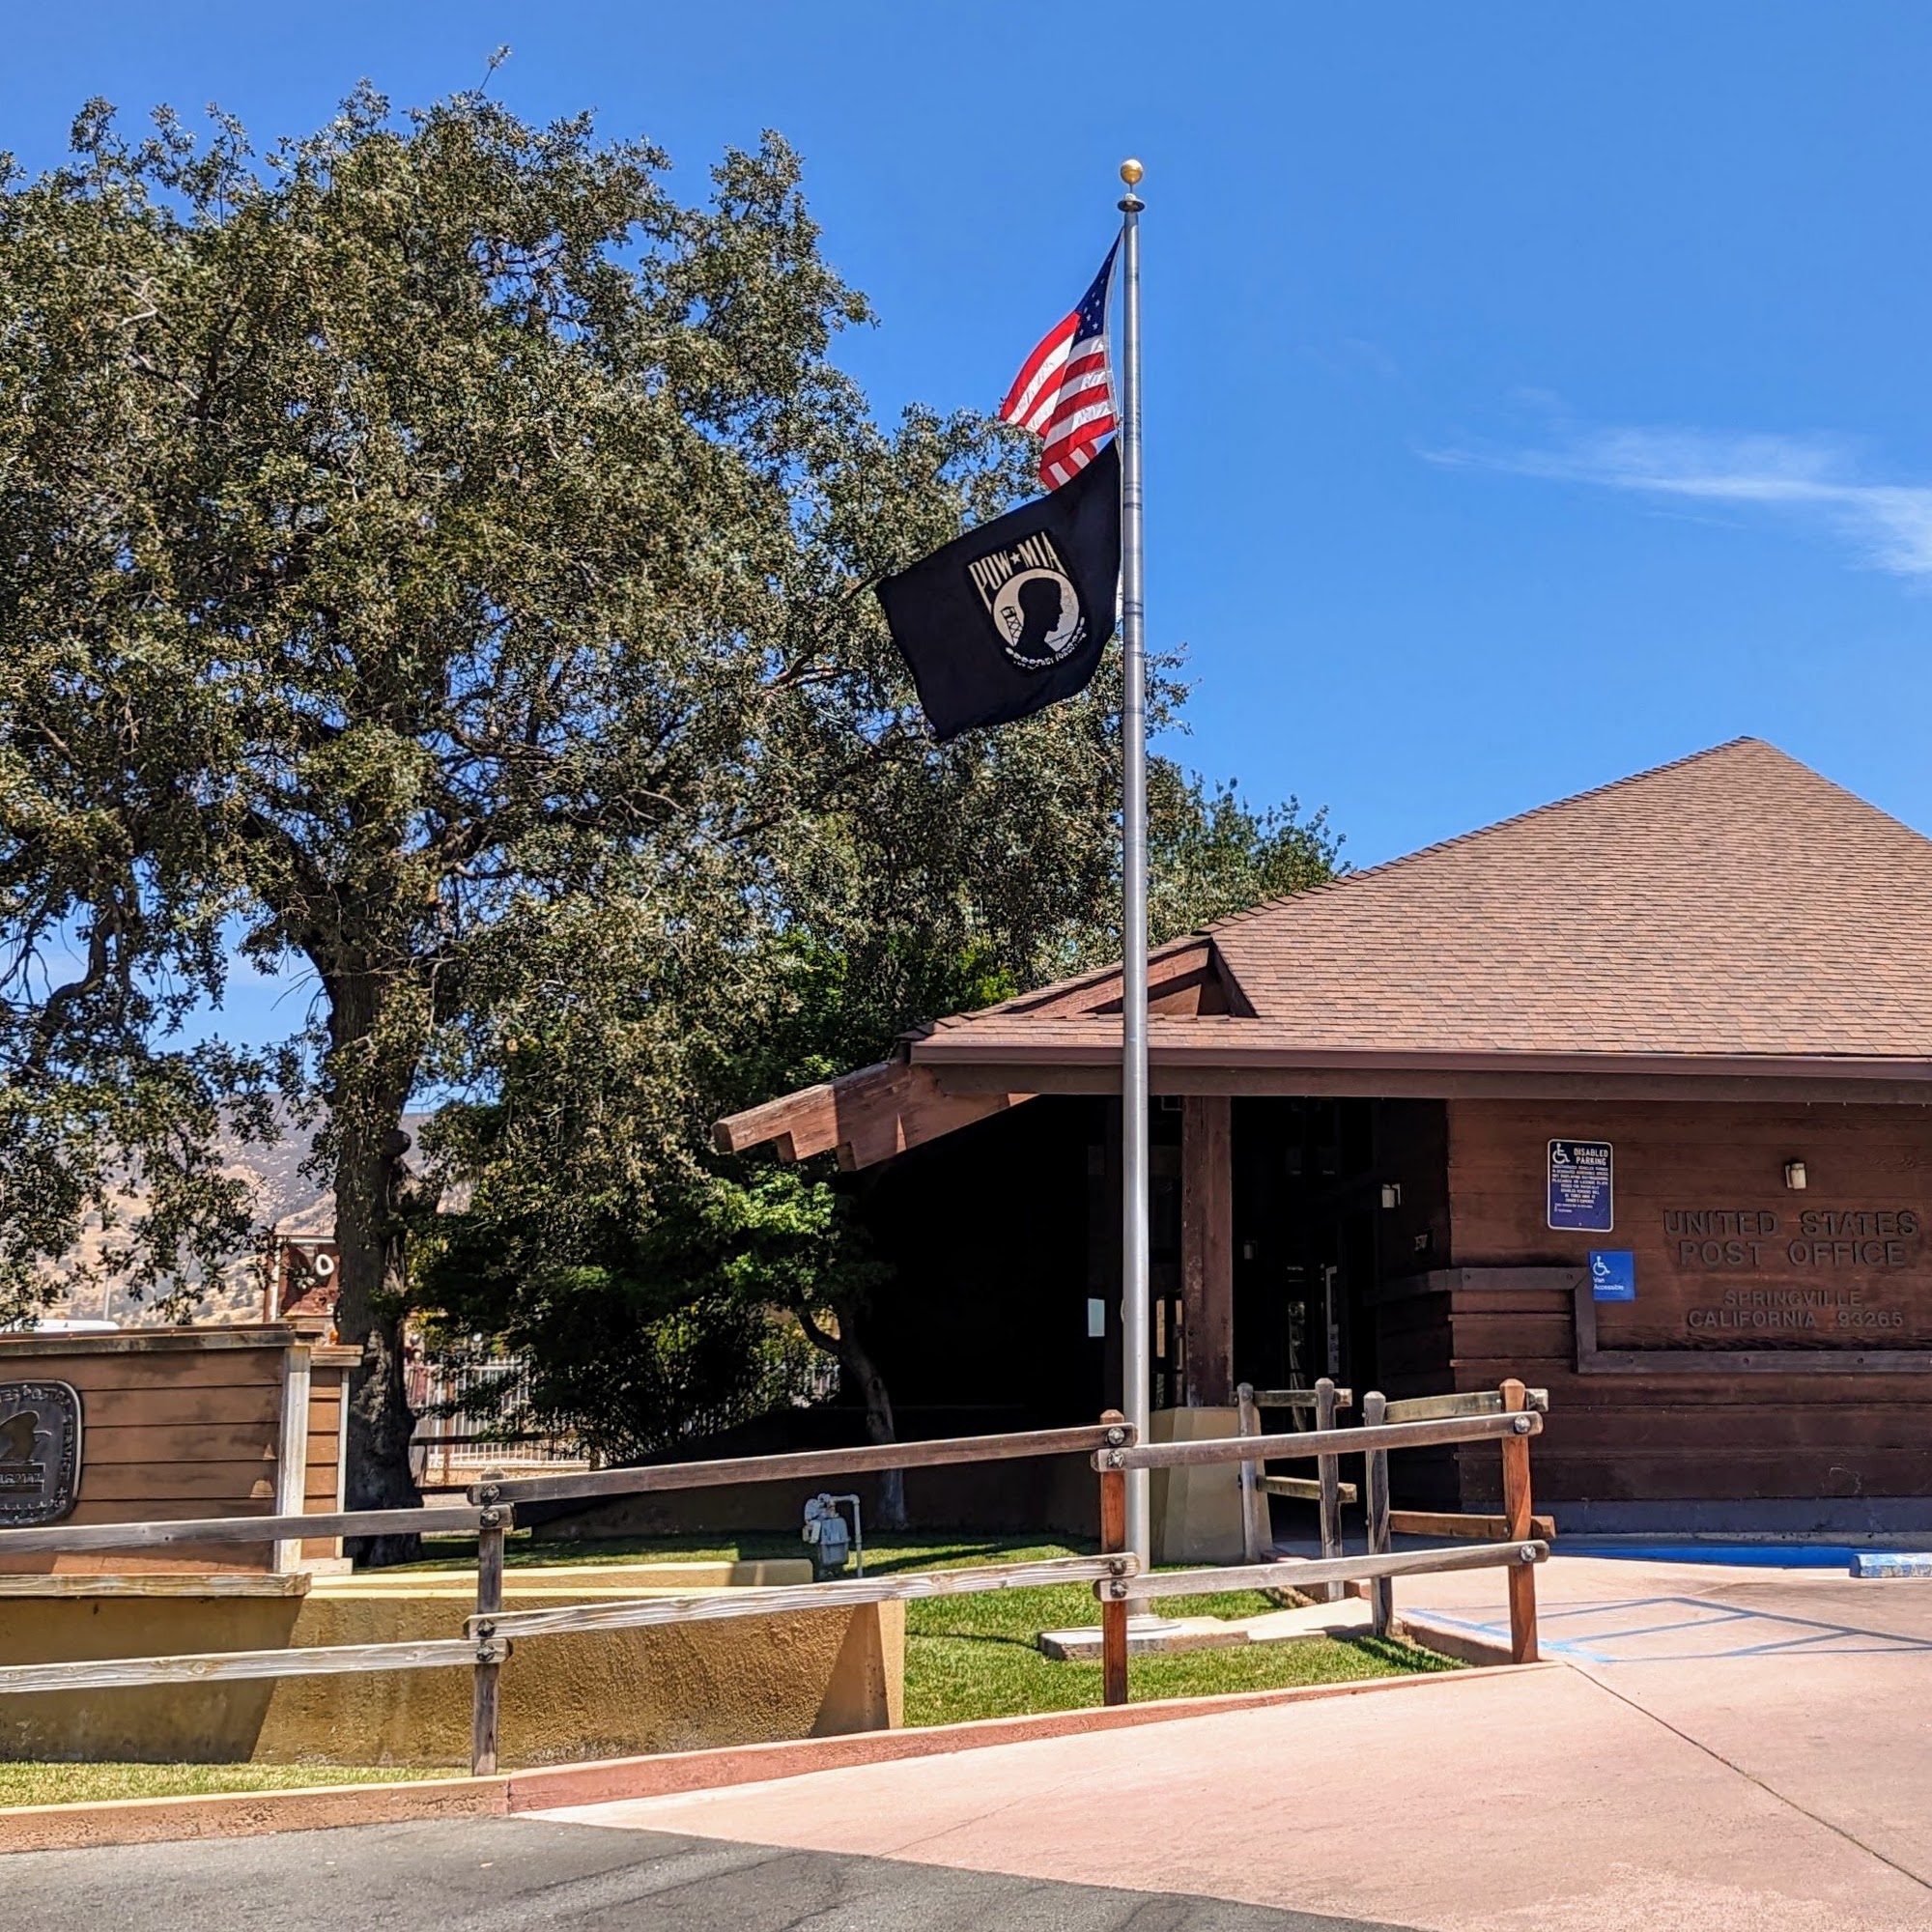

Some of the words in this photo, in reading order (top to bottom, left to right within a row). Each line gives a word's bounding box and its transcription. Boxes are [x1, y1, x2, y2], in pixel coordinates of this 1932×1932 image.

[968, 551, 1013, 614] POW
[1017, 531, 1068, 578] MIA
[1573, 1147, 1608, 1158] DISABLED
[1576, 1156, 1606, 1166] PARKING
[1662, 1210, 1779, 1236] UNITED
[1801, 1210, 1918, 1236] STATES
[1678, 1240, 1766, 1267] POST
[1789, 1239, 1907, 1267] OFFICE
[1723, 1289, 1863, 1307] SPRINGVILLE
[1689, 1311, 1818, 1328] CALIFORNIA
[1838, 1311, 1904, 1327] 93265
